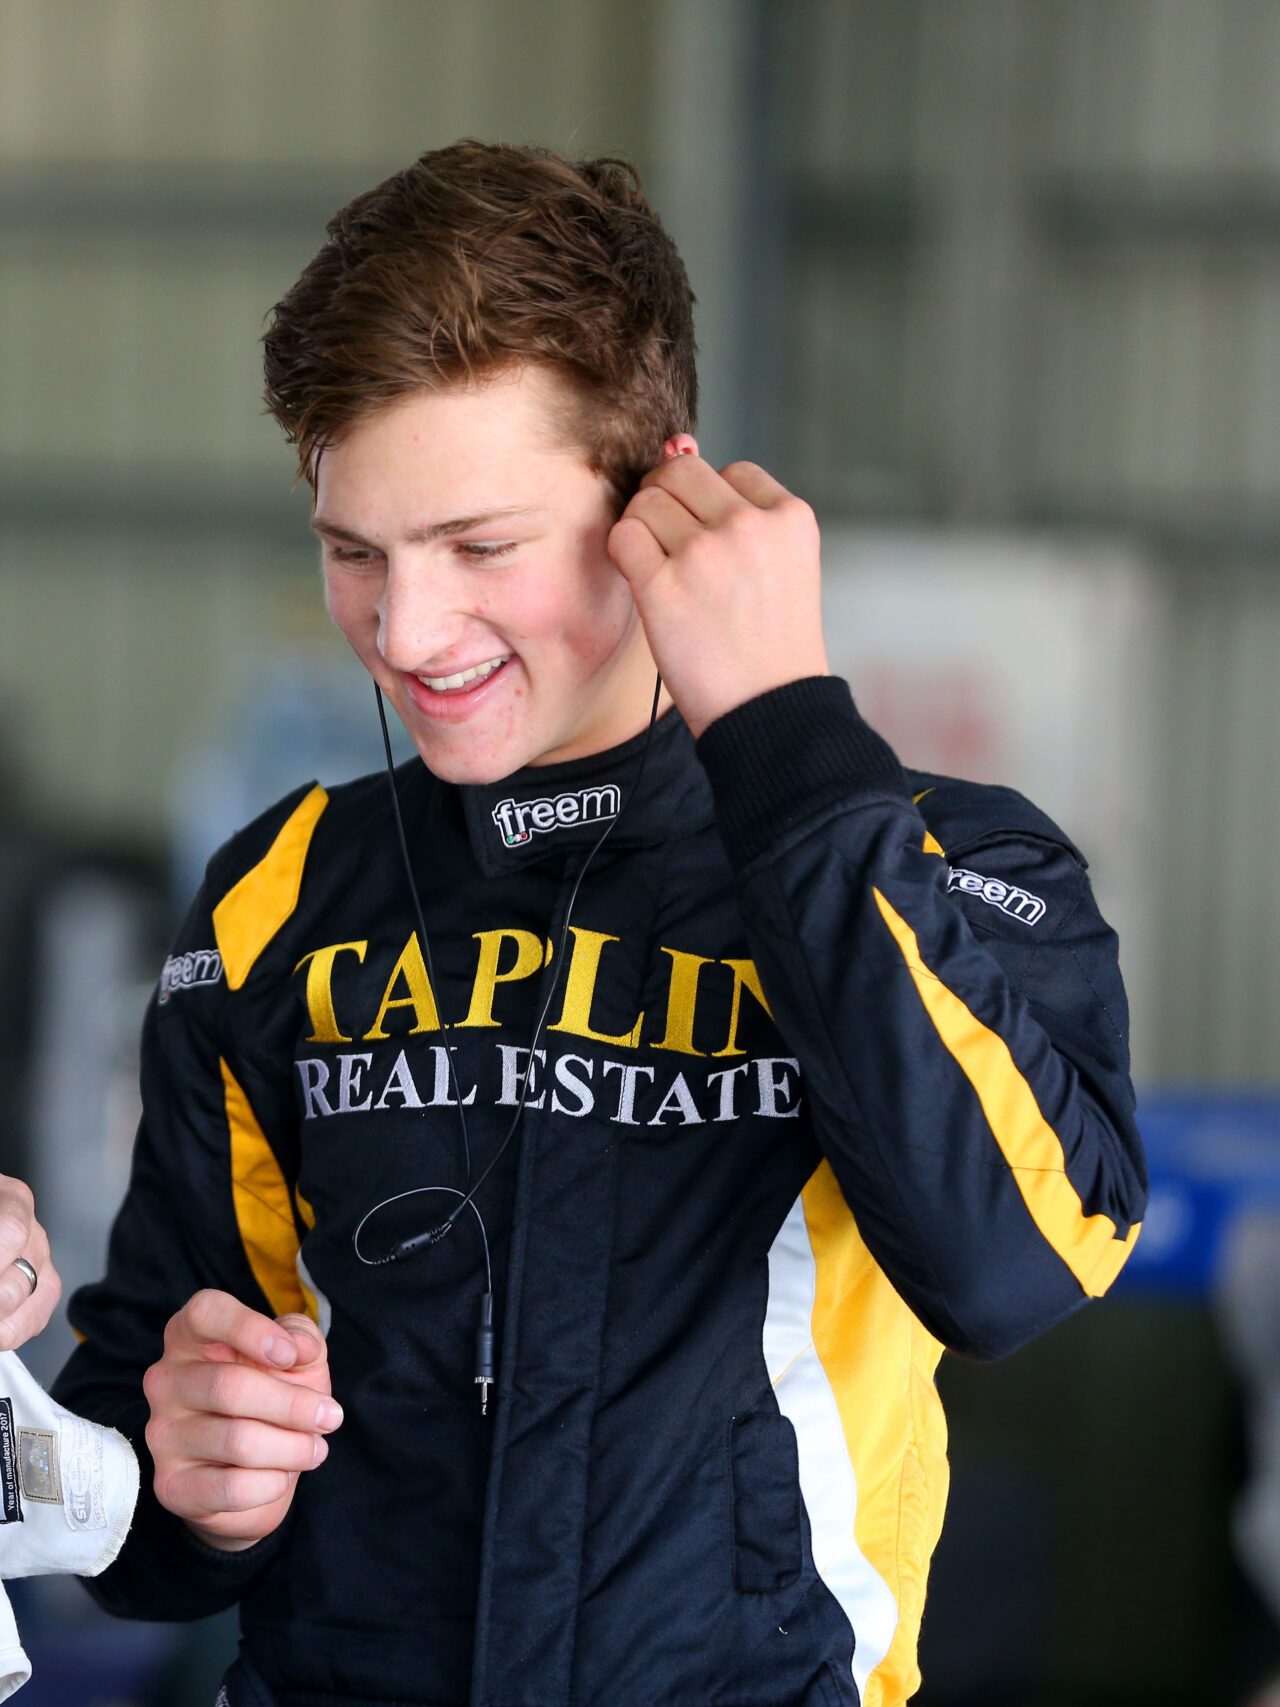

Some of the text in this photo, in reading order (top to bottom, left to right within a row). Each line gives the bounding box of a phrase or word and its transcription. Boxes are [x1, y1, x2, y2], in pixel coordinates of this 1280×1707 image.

[496, 788, 616, 839] freem
[947, 868, 1042, 922] reem
[293, 925, 775, 1058] TAPLIN
[295, 1045, 802, 1126] REAL ESTATE
[0, 1412, 15, 1511] Year of manufacture 2017
